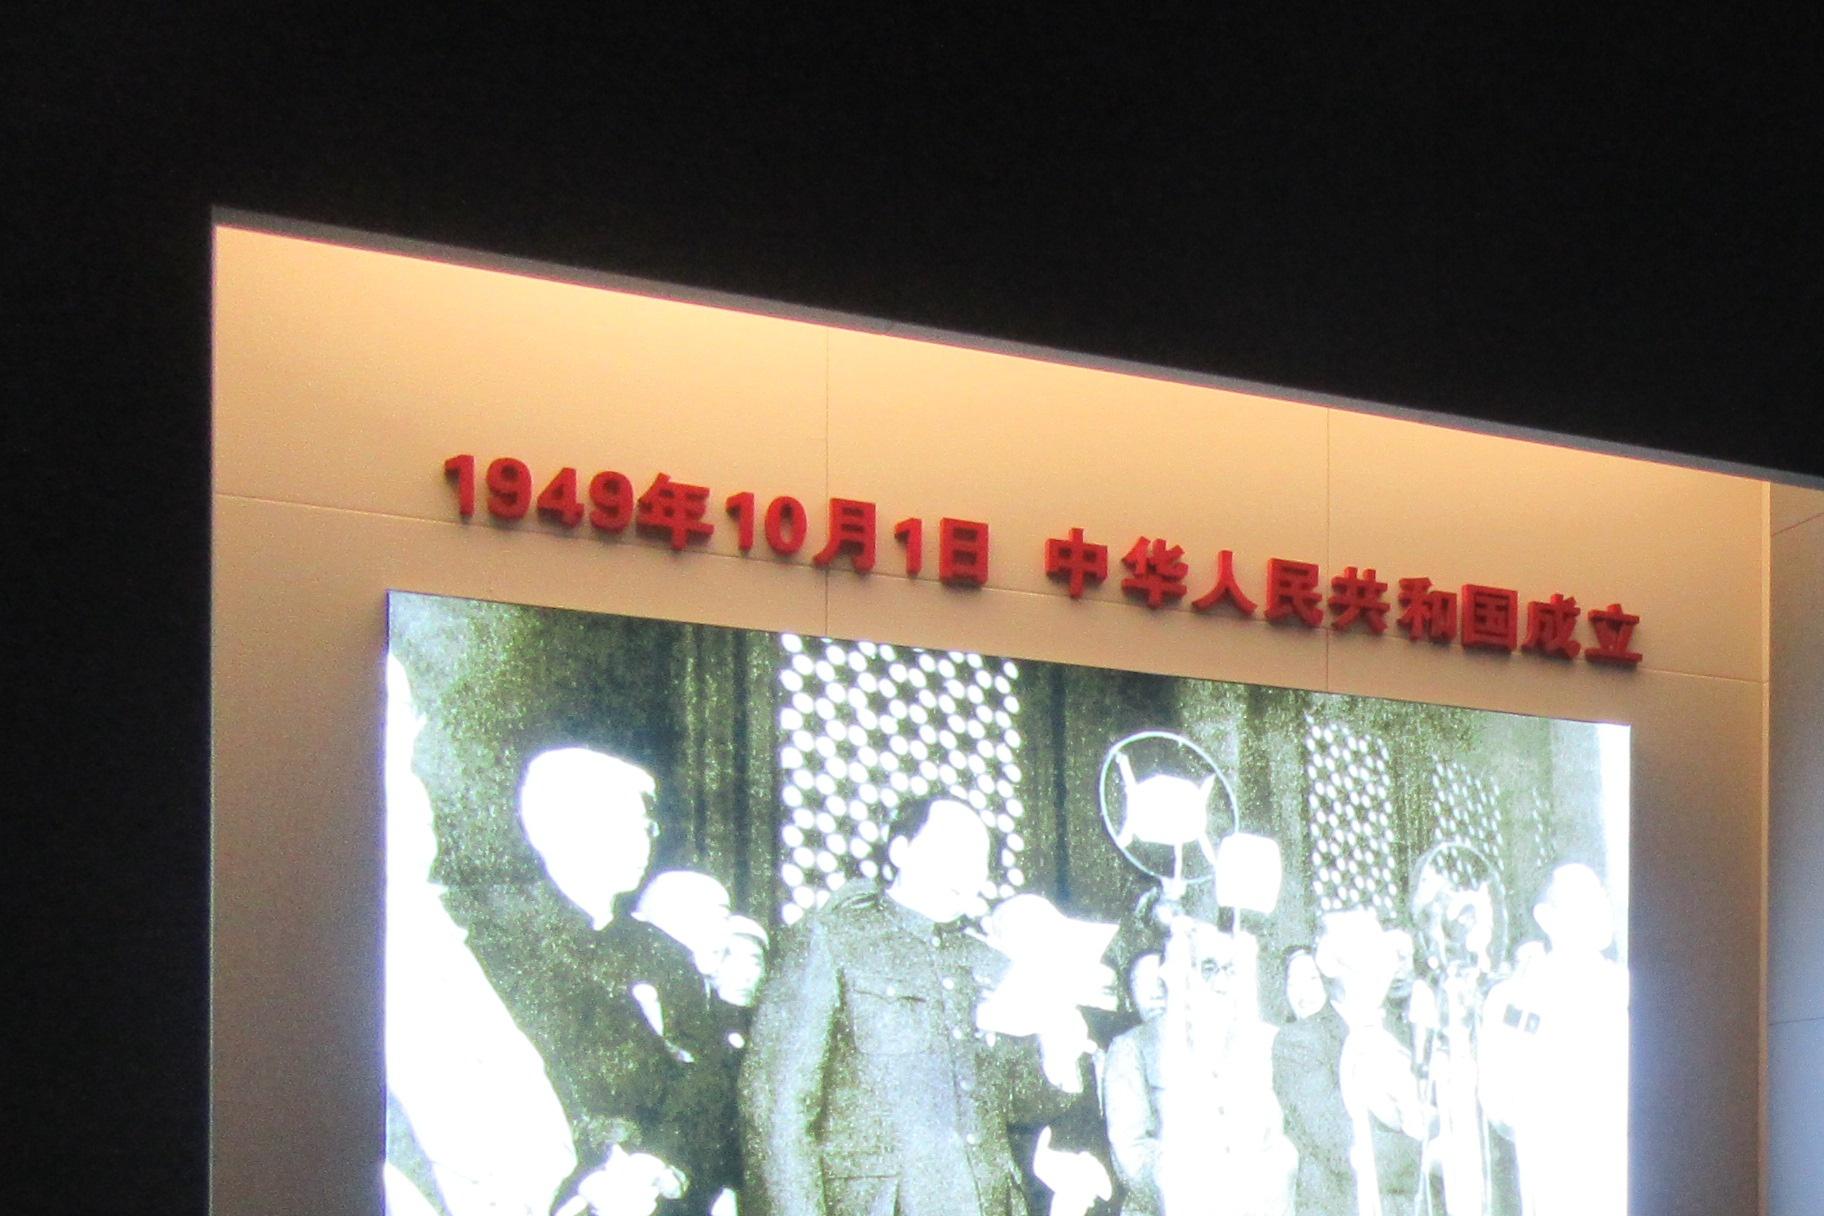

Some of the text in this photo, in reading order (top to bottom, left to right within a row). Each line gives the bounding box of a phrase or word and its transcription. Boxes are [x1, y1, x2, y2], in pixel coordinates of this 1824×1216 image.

[445, 452, 1643, 667] 1949年10月1日 中华人民共和国成立
